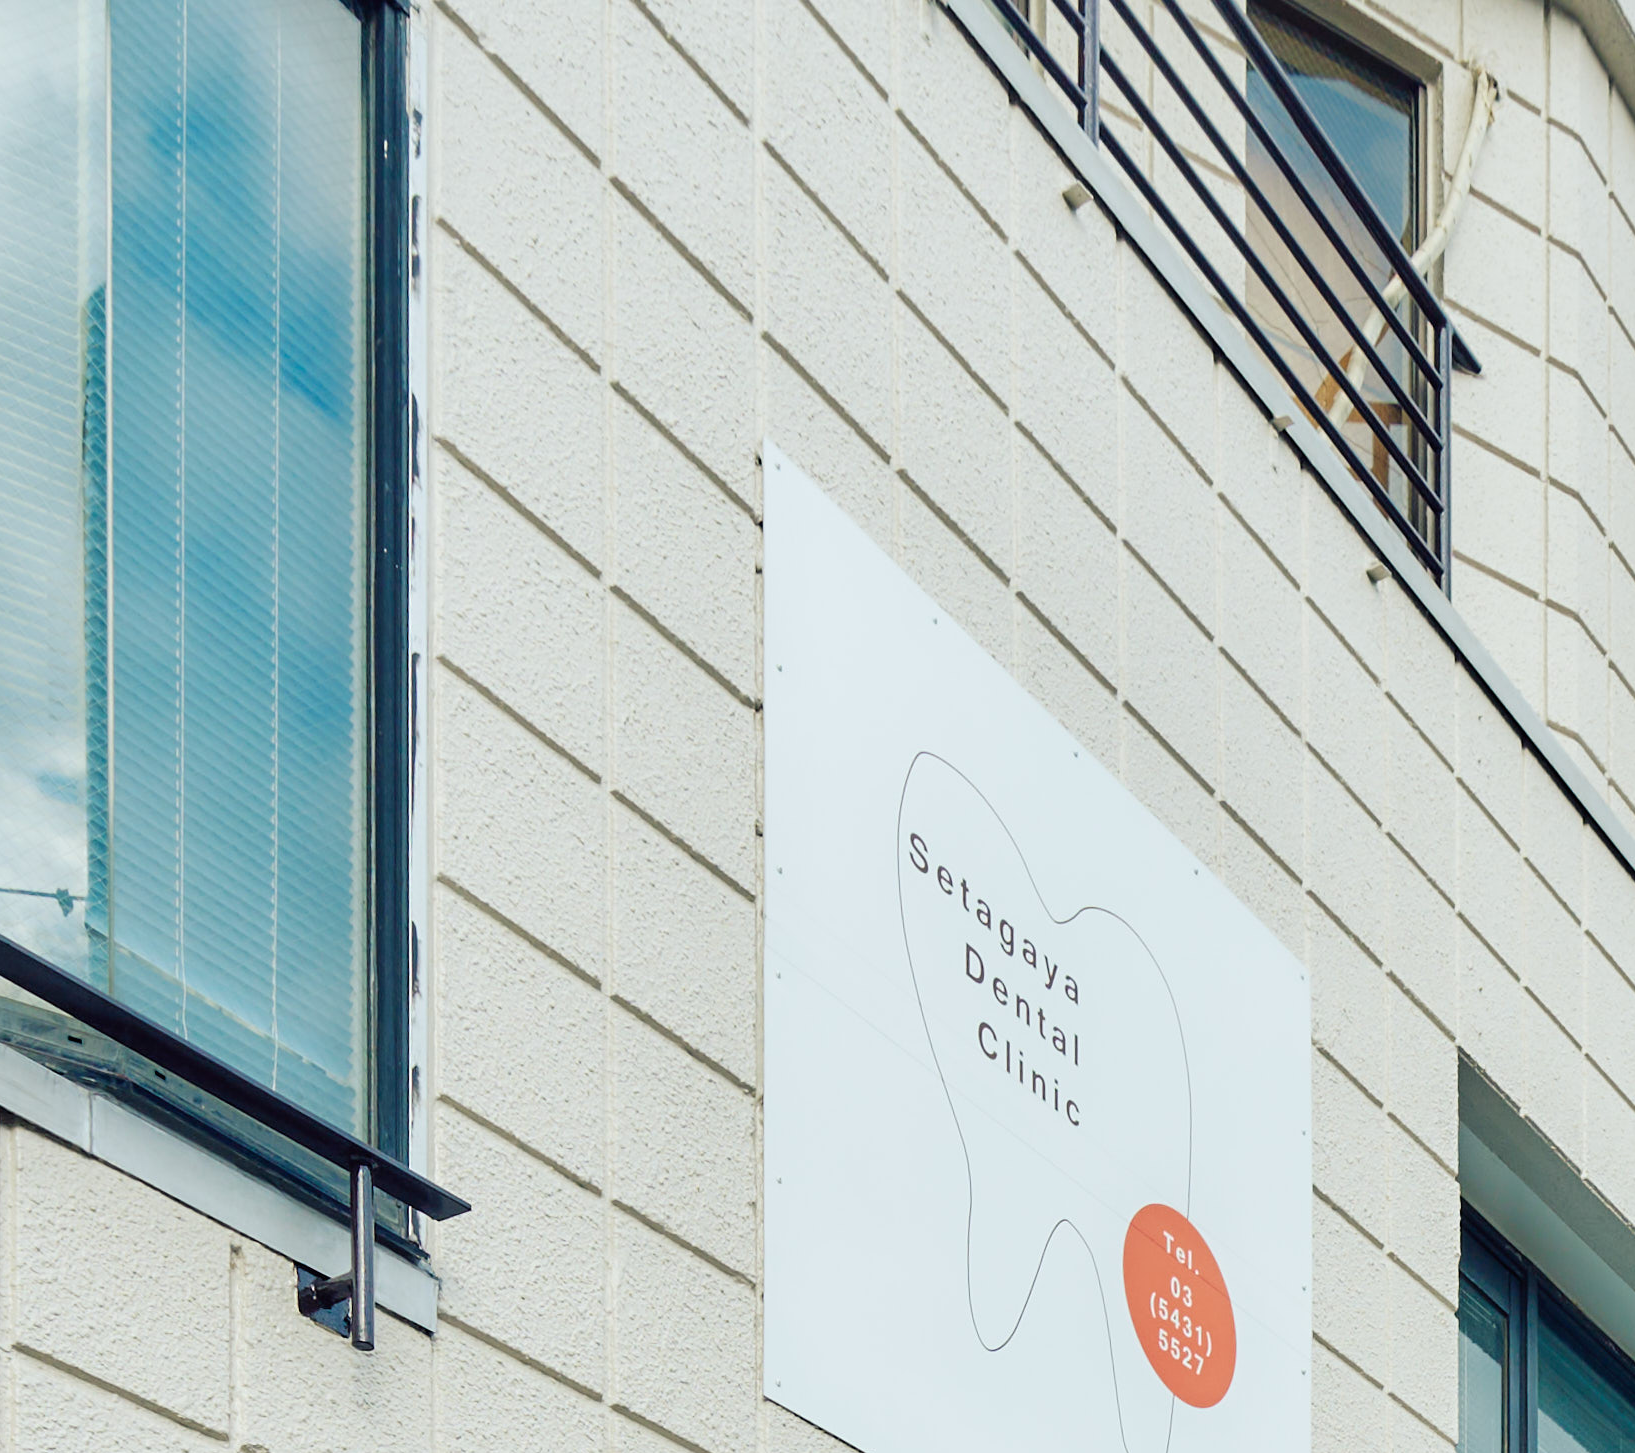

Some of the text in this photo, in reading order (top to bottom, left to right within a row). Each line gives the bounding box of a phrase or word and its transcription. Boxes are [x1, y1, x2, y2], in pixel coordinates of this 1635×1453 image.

[908, 831, 1080, 1005] Setagaya
[965, 943, 1080, 1067] Dental
[976, 1022, 1080, 1128] Clinic
[1162, 1230, 1200, 1276] Tel.
[1149, 1291, 1214, 1358] (5431)
[1170, 1276, 1194, 1309] 03
[1157, 1327, 1205, 1377] 5527
